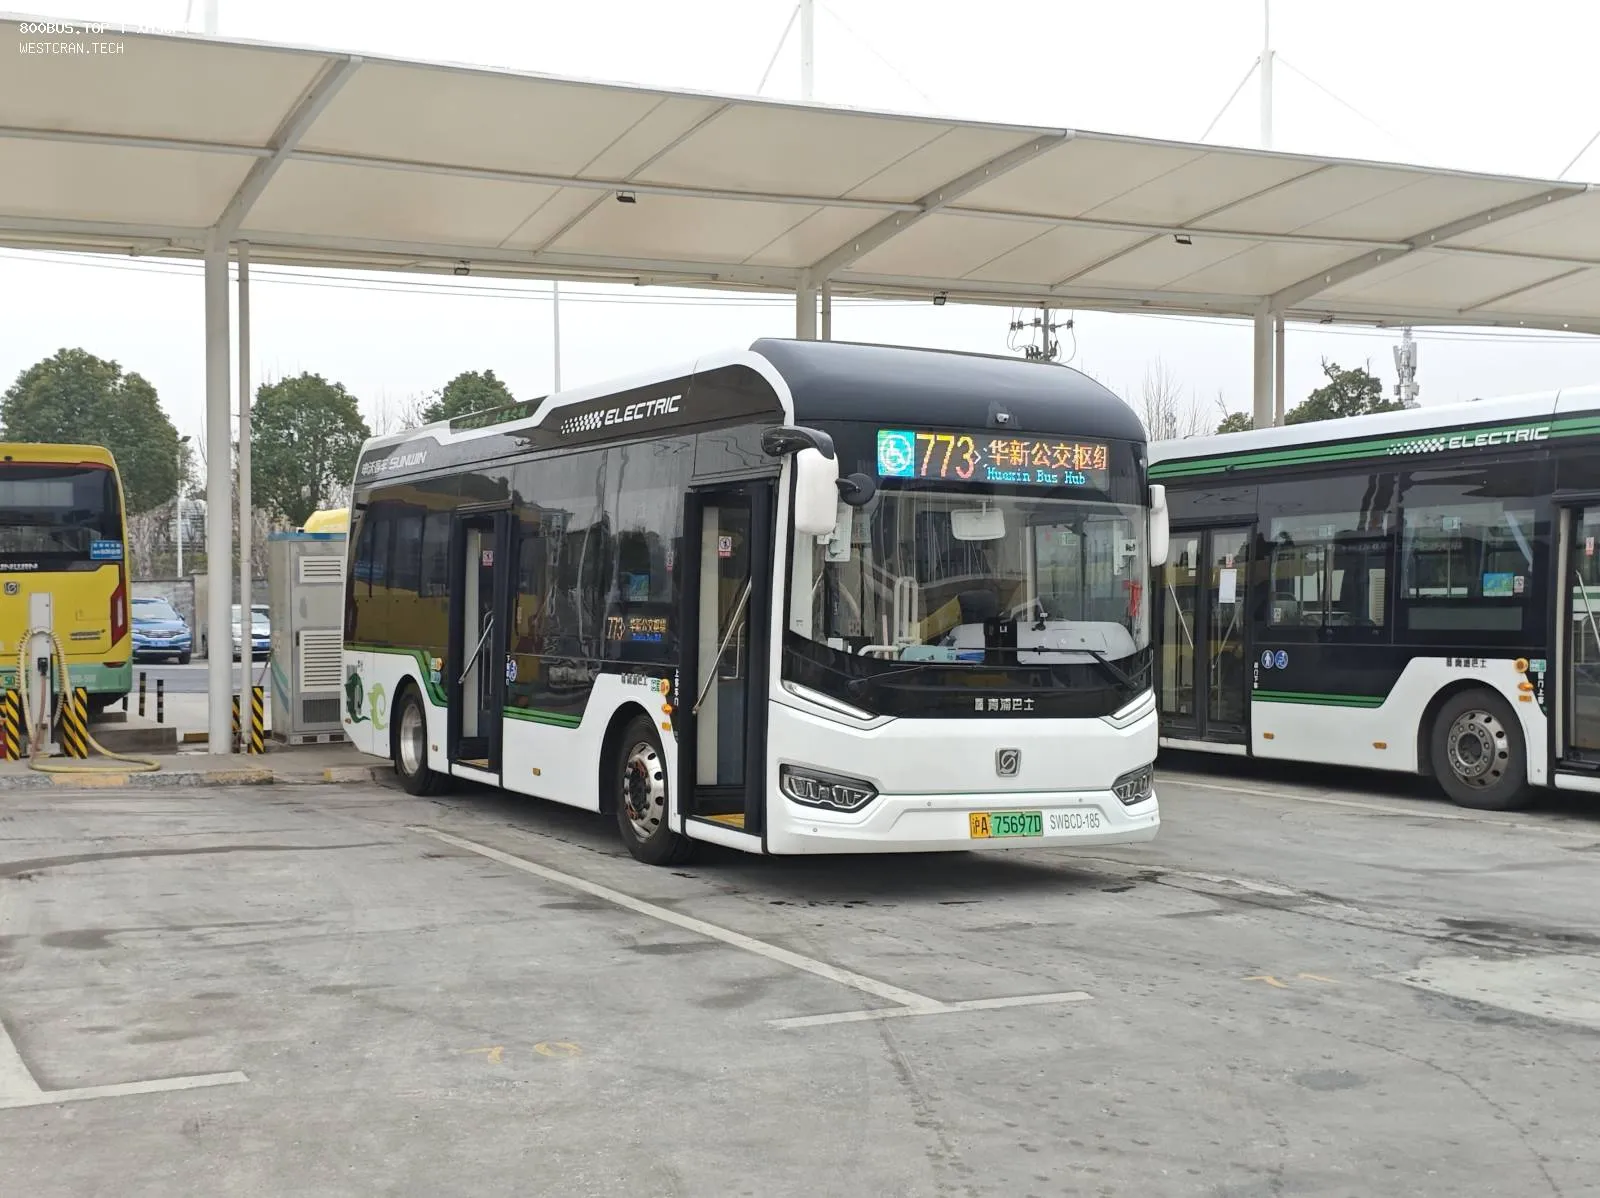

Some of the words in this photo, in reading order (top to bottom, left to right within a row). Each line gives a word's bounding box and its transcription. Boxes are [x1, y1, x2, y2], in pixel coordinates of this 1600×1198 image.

[604, 394, 682, 426] ELECTRIC
[1448, 426, 1549, 449] ELECTRIC
[389, 450, 428, 469] SUNWIN
[916, 433, 976, 479] 773
[986, 466, 1031, 482] Huaxin
[1036, 470, 1058, 483] Bus
[1064, 471, 1086, 485] Hub
[607, 616, 623, 640] 773
[994, 815, 1041, 834] 75697D
[1049, 812, 1100, 830] SWBCD-185
